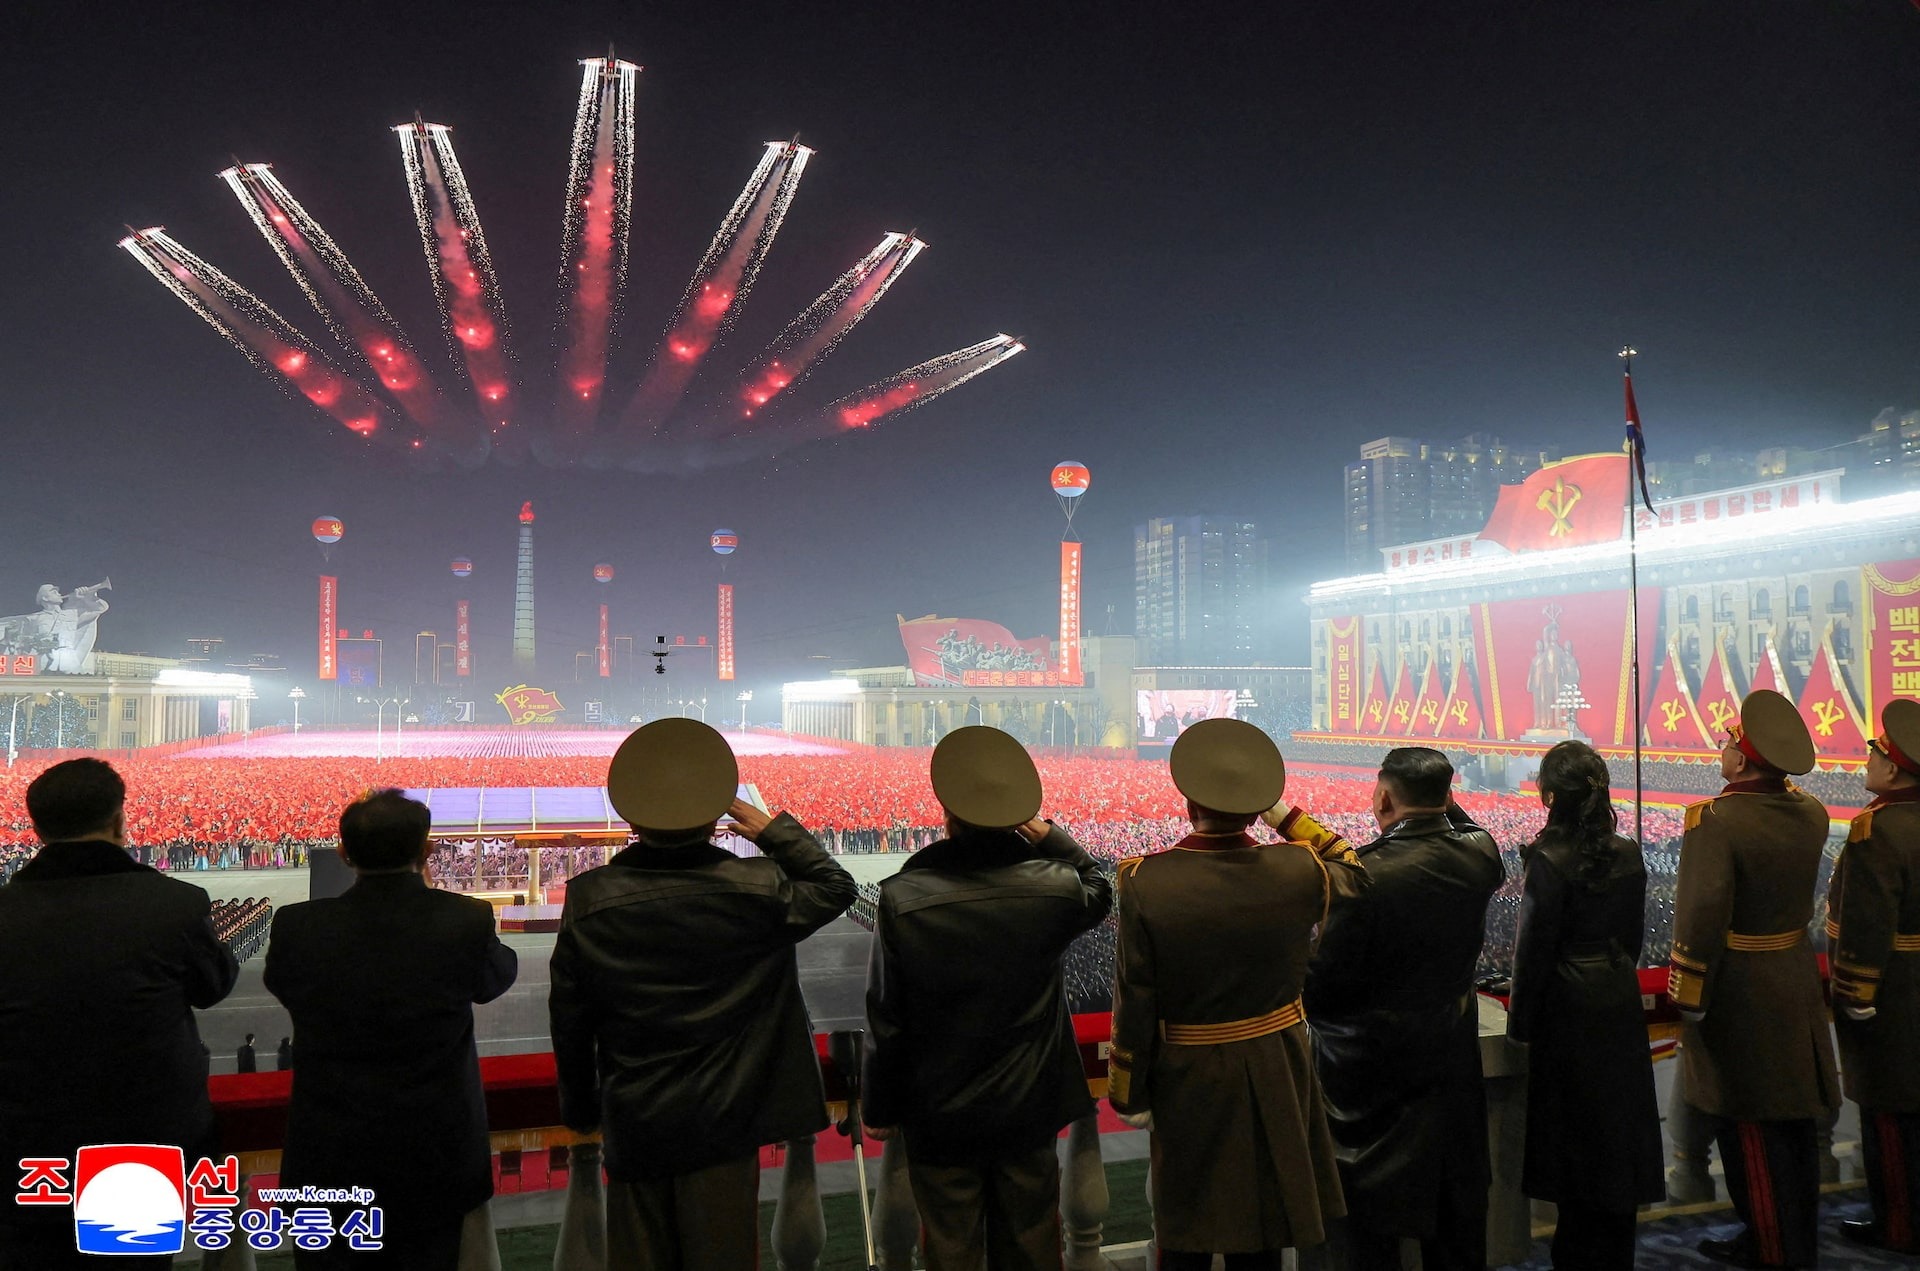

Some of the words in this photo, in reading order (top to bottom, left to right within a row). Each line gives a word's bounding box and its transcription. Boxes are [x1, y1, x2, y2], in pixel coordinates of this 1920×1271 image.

[1391, 540, 1472, 568] 영광스러운
[1338, 644, 1350, 720] 일심단결
[1889, 606, 1920, 700] 백전백
